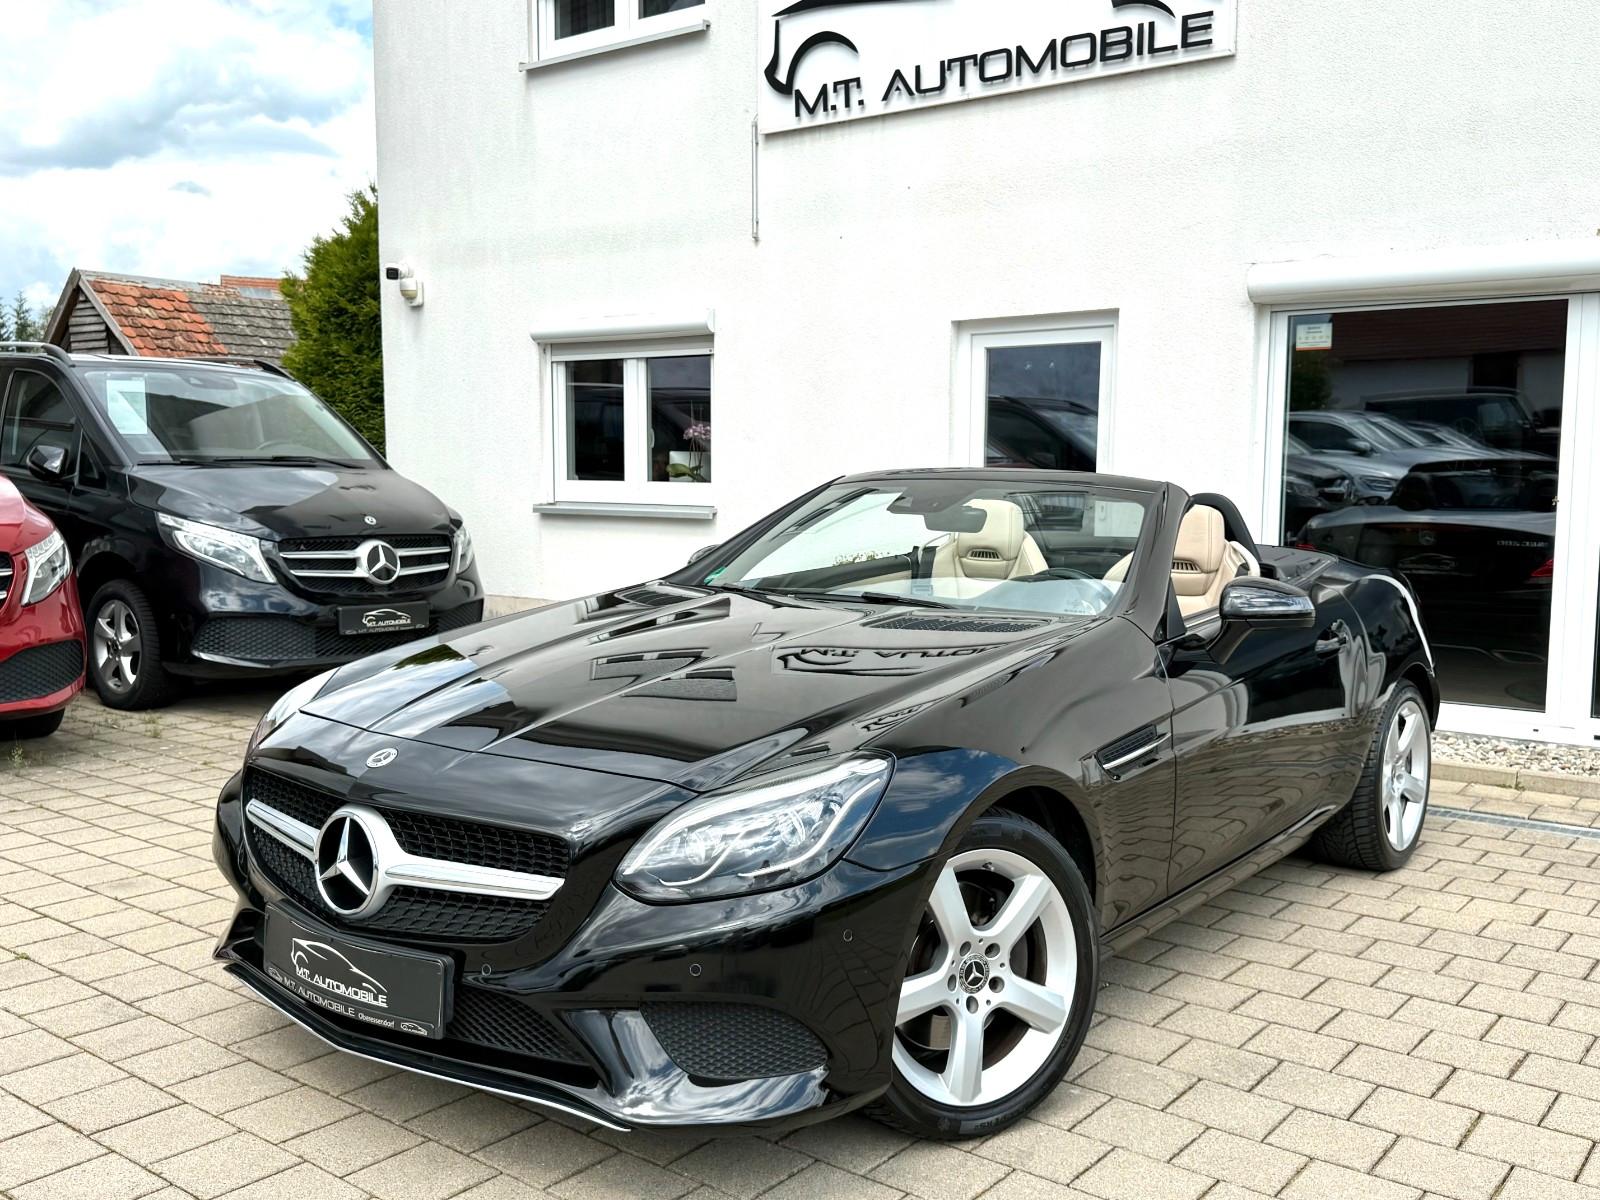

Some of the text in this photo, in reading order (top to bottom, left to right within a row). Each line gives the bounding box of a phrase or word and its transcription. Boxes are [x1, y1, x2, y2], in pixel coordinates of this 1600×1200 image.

[794, 10, 1214, 118] M.T. AUTOMOBILE
[298, 986, 355, 1017] AUTOMOBILE
[313, 973, 388, 1007] AUTOMOBILE
